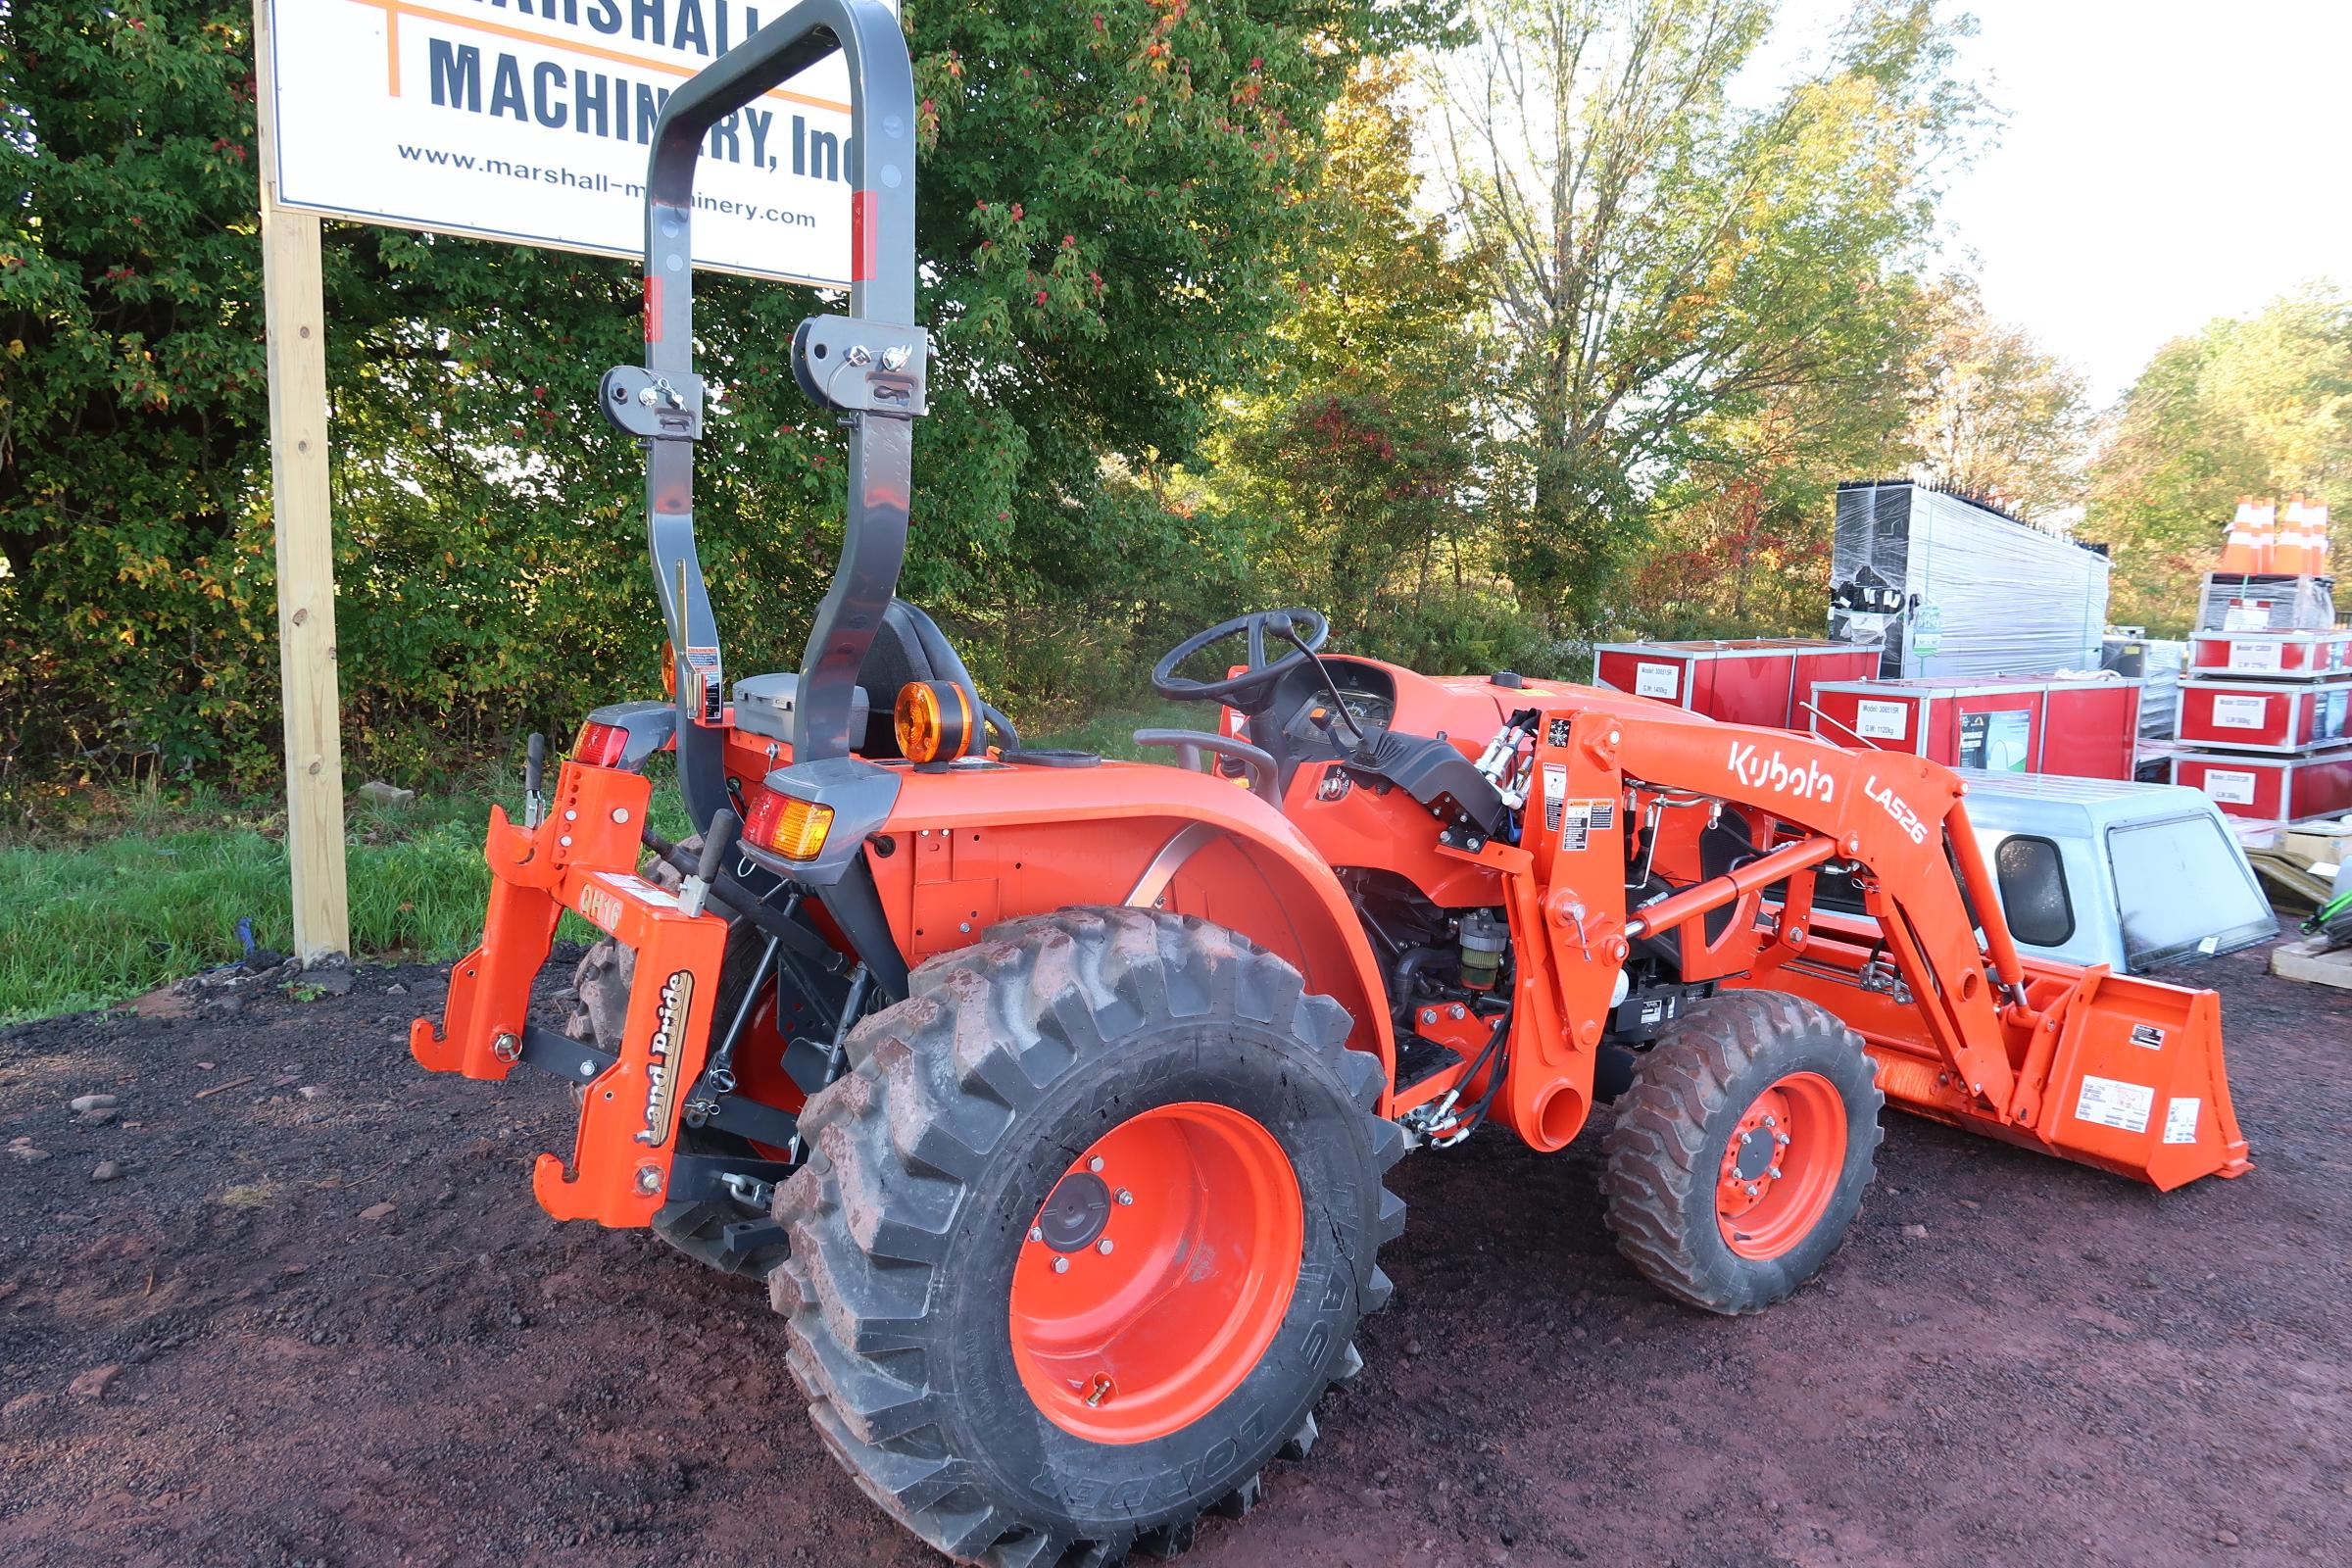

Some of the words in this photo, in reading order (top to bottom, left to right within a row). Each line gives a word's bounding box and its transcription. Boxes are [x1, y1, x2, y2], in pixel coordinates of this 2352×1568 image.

[475, 0, 759, 56] SHAL
[429, 37, 777, 173] MACHINRY,
[398, 144, 816, 227] www.marshall-minery.com
[1728, 741, 1835, 804] Kubota
[1863, 775, 1929, 845] LA526
[580, 883, 620, 931] QH16
[651, 972, 685, 1058] Pride
[635, 1063, 669, 1147] Land
